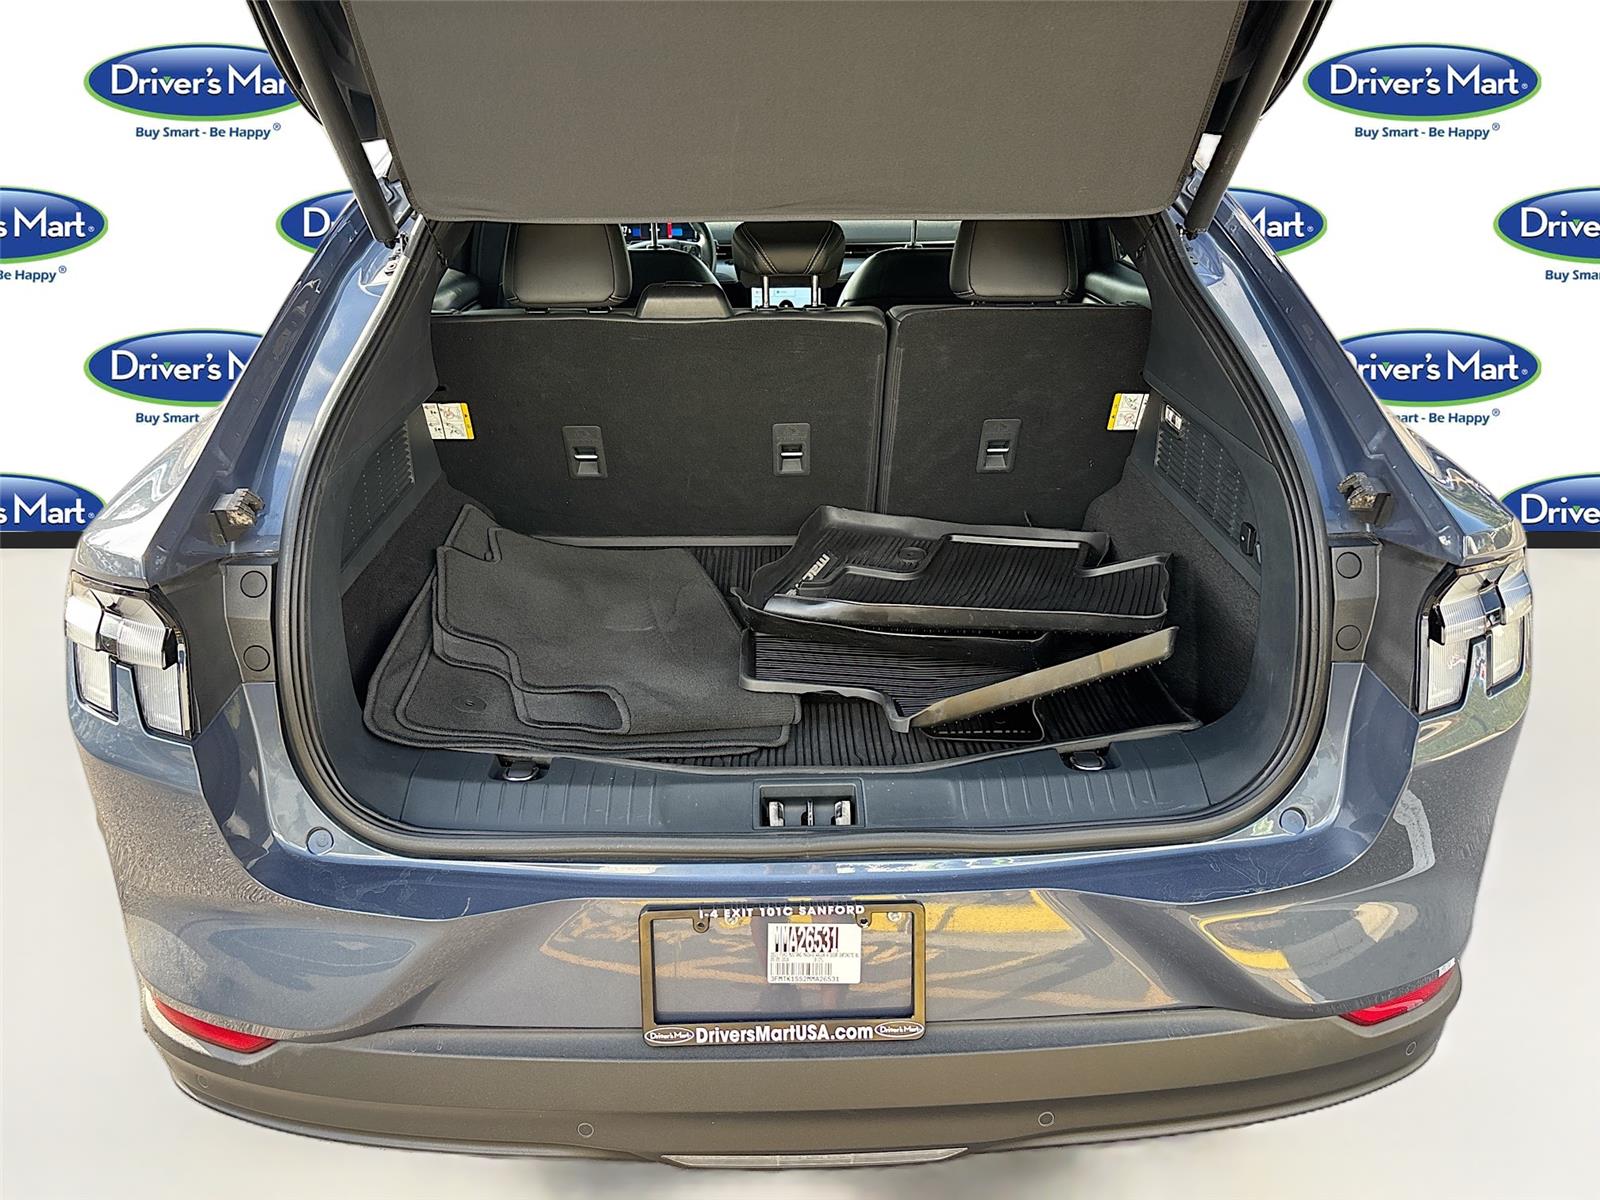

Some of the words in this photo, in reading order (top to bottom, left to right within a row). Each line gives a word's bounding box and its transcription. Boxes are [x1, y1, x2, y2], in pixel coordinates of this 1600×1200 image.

[111, 63, 222, 95] Driver's
[228, 64, 289, 95] Mar
[1330, 63, 1441, 95] Driver's
[1447, 64, 1519, 95] Mart
[135, 126, 159, 141] Buy
[162, 126, 200, 138] Smart
[209, 126, 226, 138] Be
[229, 126, 271, 141] Happy
[1354, 126, 1379, 141] Buy
[1382, 126, 1419, 138] Smart
[1428, 126, 1445, 138] Be
[1448, 126, 1490, 141] Happy
[14, 206, 86, 238] Mart
[15, 269, 57, 283] Happy
[1545, 269, 1570, 283] Buy
[1572, 269, 1600, 280] Sma
[111, 349, 222, 381] Driver's
[1447, 349, 1519, 381] Mart
[135, 412, 160, 426] Buy
[162, 412, 200, 423] Smart
[1396, 412, 1419, 423] art
[1428, 412, 1445, 423] Be
[1448, 412, 1490, 426] Happy
[14, 492, 86, 524] Mart
[724, 907, 754, 918] EXIT
[760, 906, 793, 917] 101C
[799, 904, 865, 915] SANFORD
[695, 1024, 874, 1044] DriversMartUSA.com
